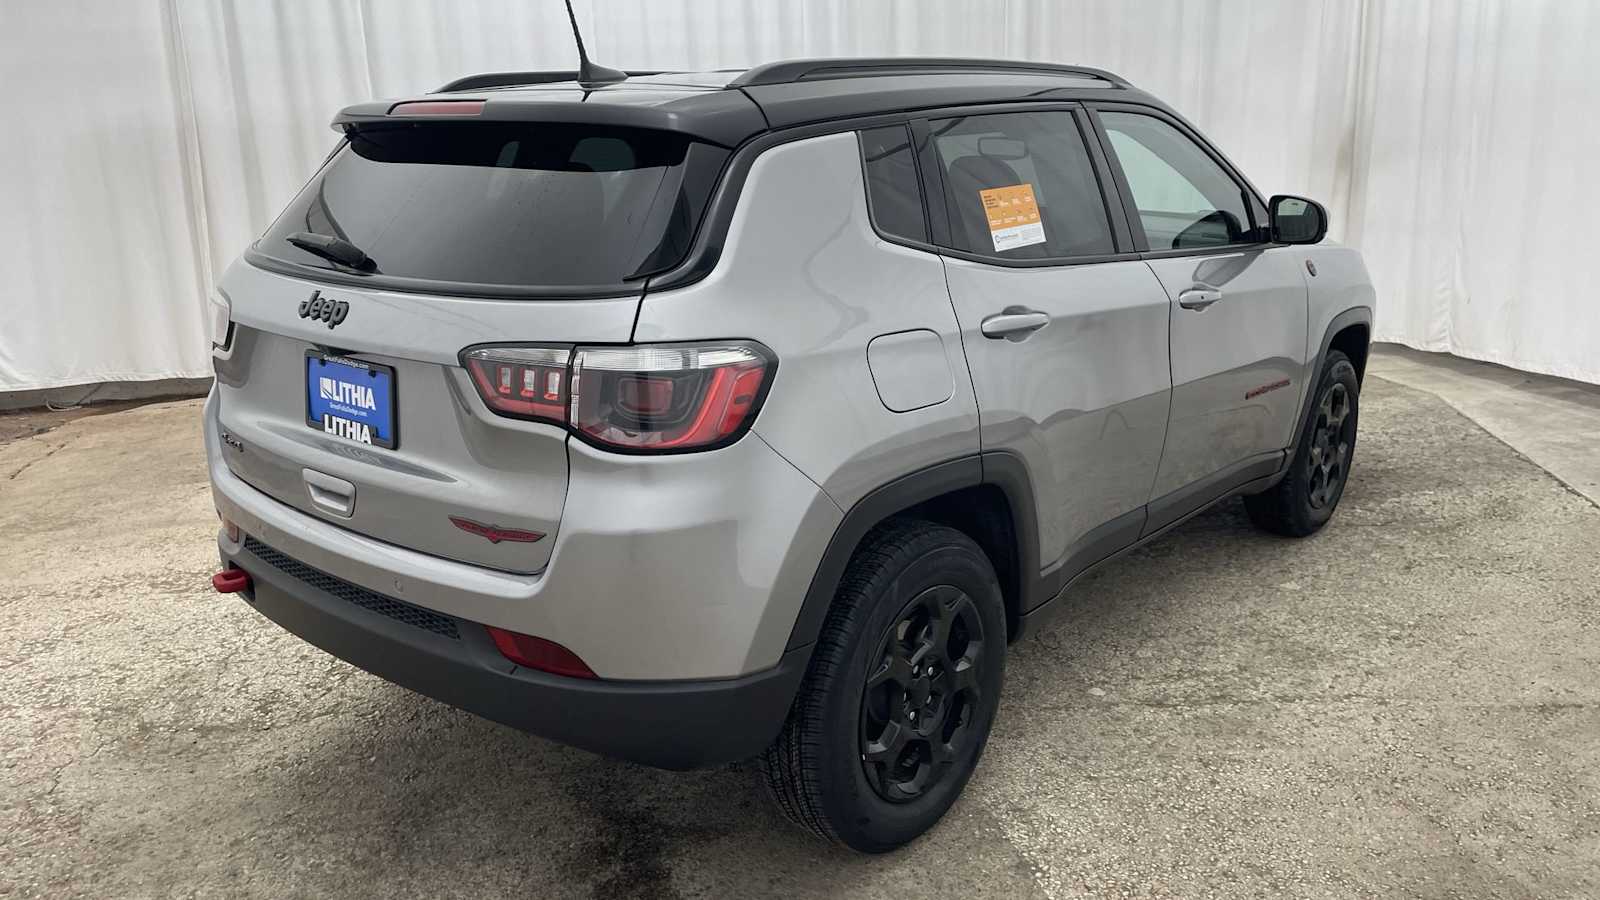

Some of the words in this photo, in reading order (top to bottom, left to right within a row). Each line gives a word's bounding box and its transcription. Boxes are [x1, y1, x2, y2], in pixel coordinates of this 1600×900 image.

[298, 290, 350, 330] Jeep
[332, 379, 376, 411] LITHIA
[324, 414, 372, 445] LITHIA
